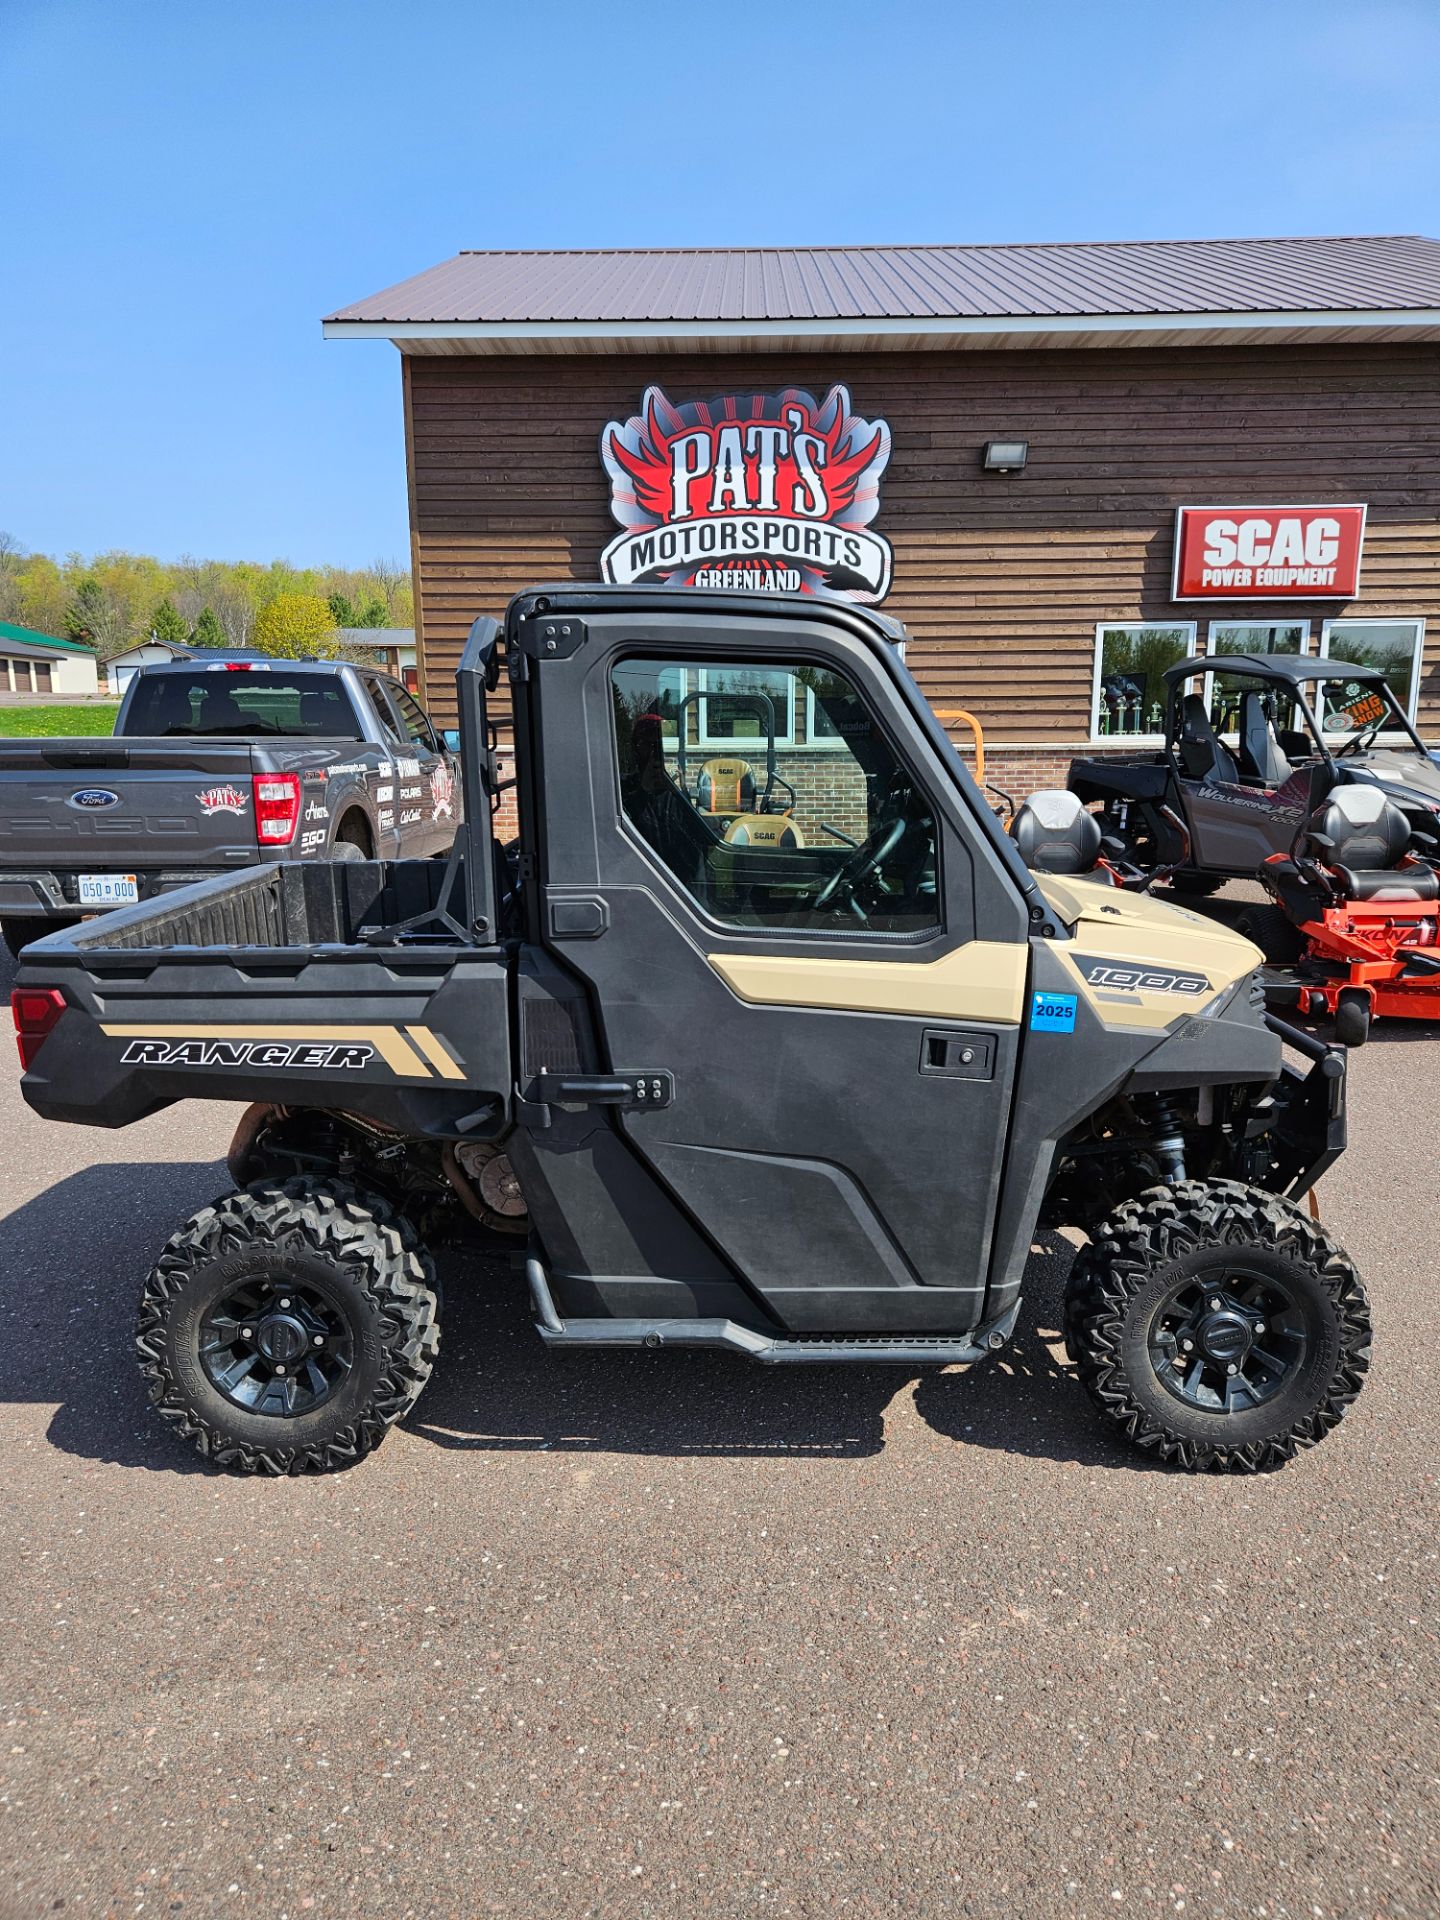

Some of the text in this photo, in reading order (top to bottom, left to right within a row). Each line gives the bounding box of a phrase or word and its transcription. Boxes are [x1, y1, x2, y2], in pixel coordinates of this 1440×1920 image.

[670, 408, 827, 519] PAT'S
[630, 521, 862, 571] MOTORSPORTS
[1203, 518, 1341, 567] SCAG
[695, 569, 801, 592] GREENLAND
[1202, 567, 1337, 587] POWER EQUIPMENT
[81, 793, 106, 805] Ford
[209, 788, 238, 807] PAT'S
[301, 829, 327, 848] EGO
[754, 832, 776, 840] SCAG
[82, 882, 103, 897] 050
[114, 882, 134, 897] 000
[1087, 966, 1209, 995] 1000
[1035, 1004, 1073, 1018] 2025
[120, 1040, 374, 1069] RANGER
